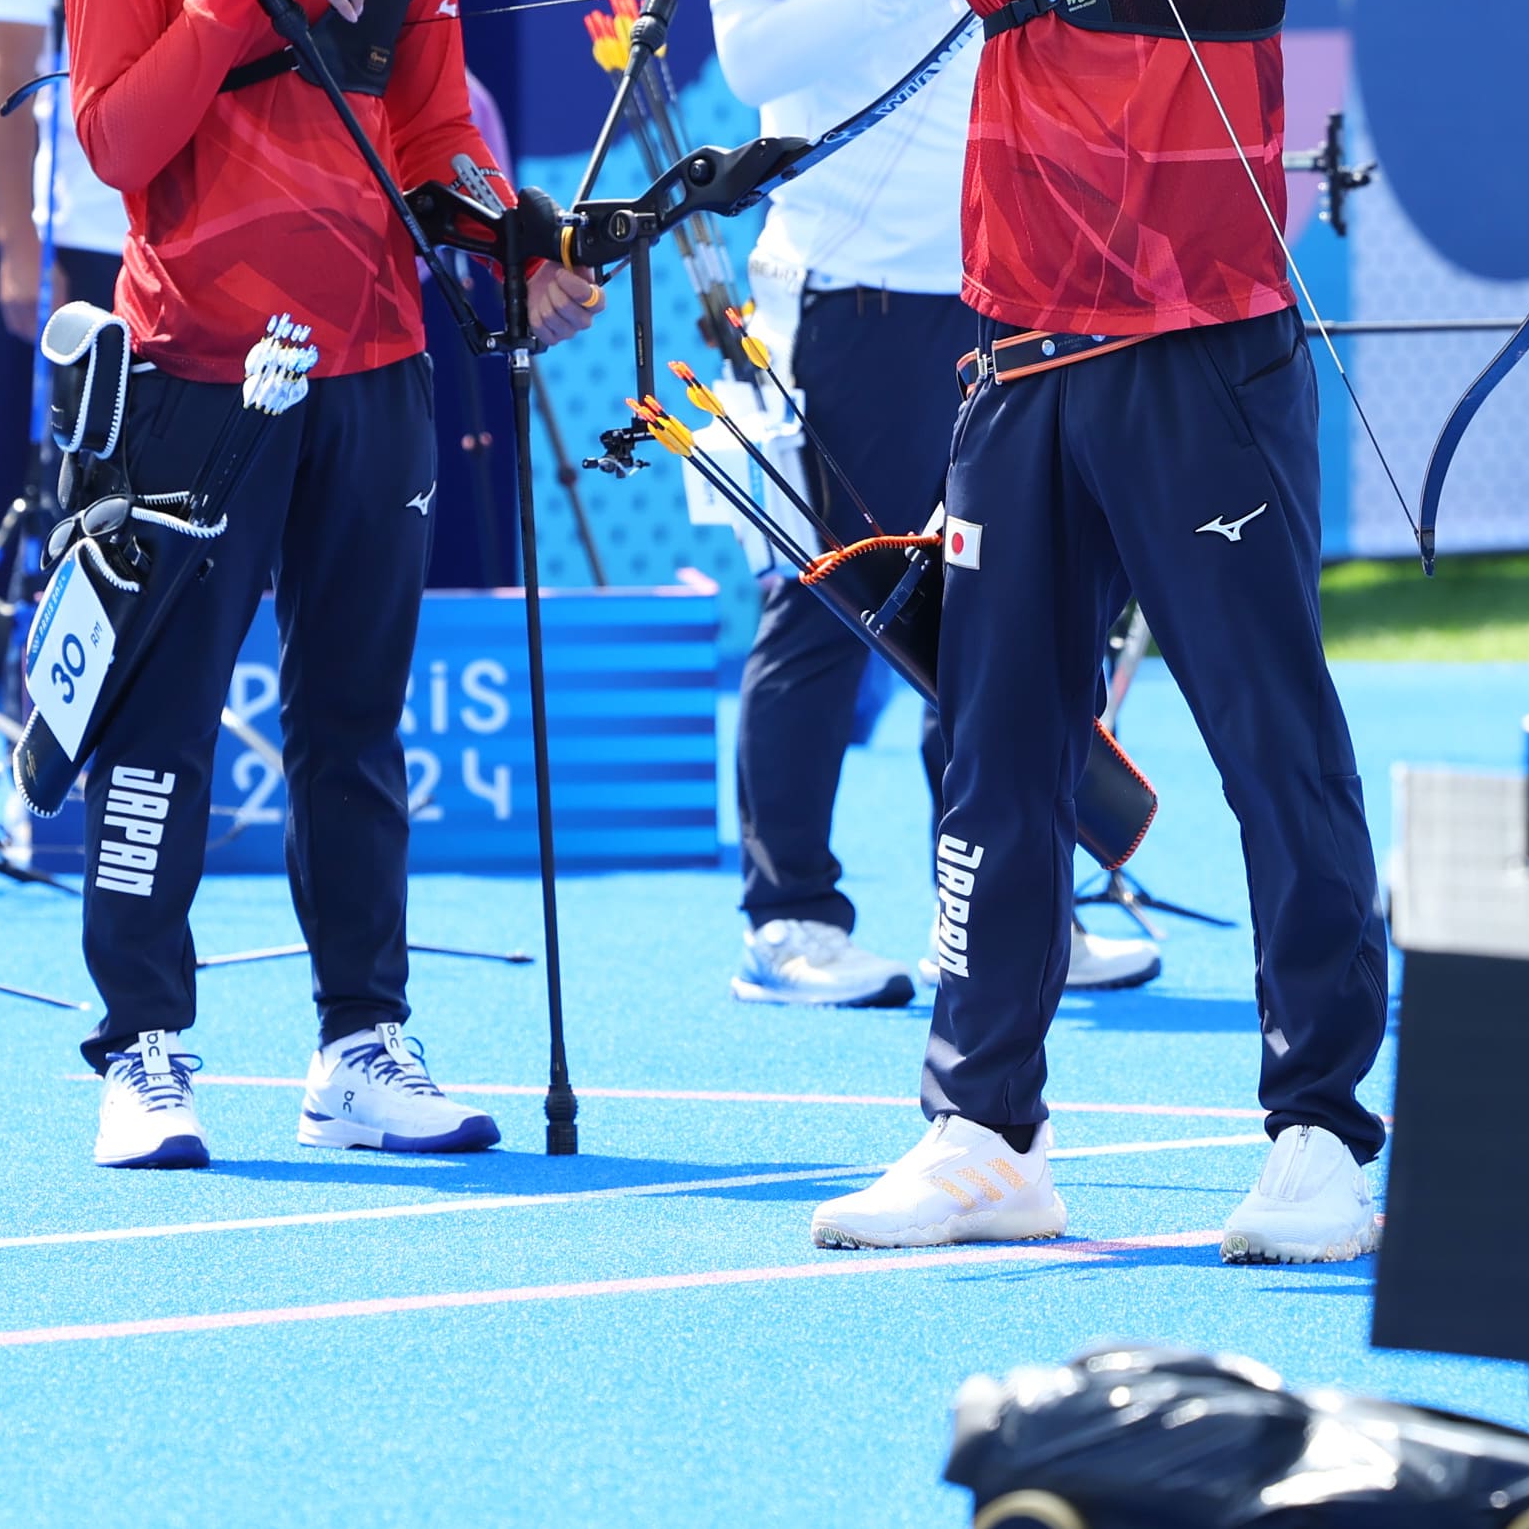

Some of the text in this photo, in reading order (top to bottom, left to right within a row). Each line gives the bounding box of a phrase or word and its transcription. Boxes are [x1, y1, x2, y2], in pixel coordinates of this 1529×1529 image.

[38, 604, 54, 638] PARIS
[90, 621, 103, 648] RM
[51, 633, 86, 704] 30
[230, 658, 510, 734] PiS
[232, 746, 511, 825] 224
[95, 765, 176, 897] JAPAN
[937, 833, 985, 978] JAPAN
